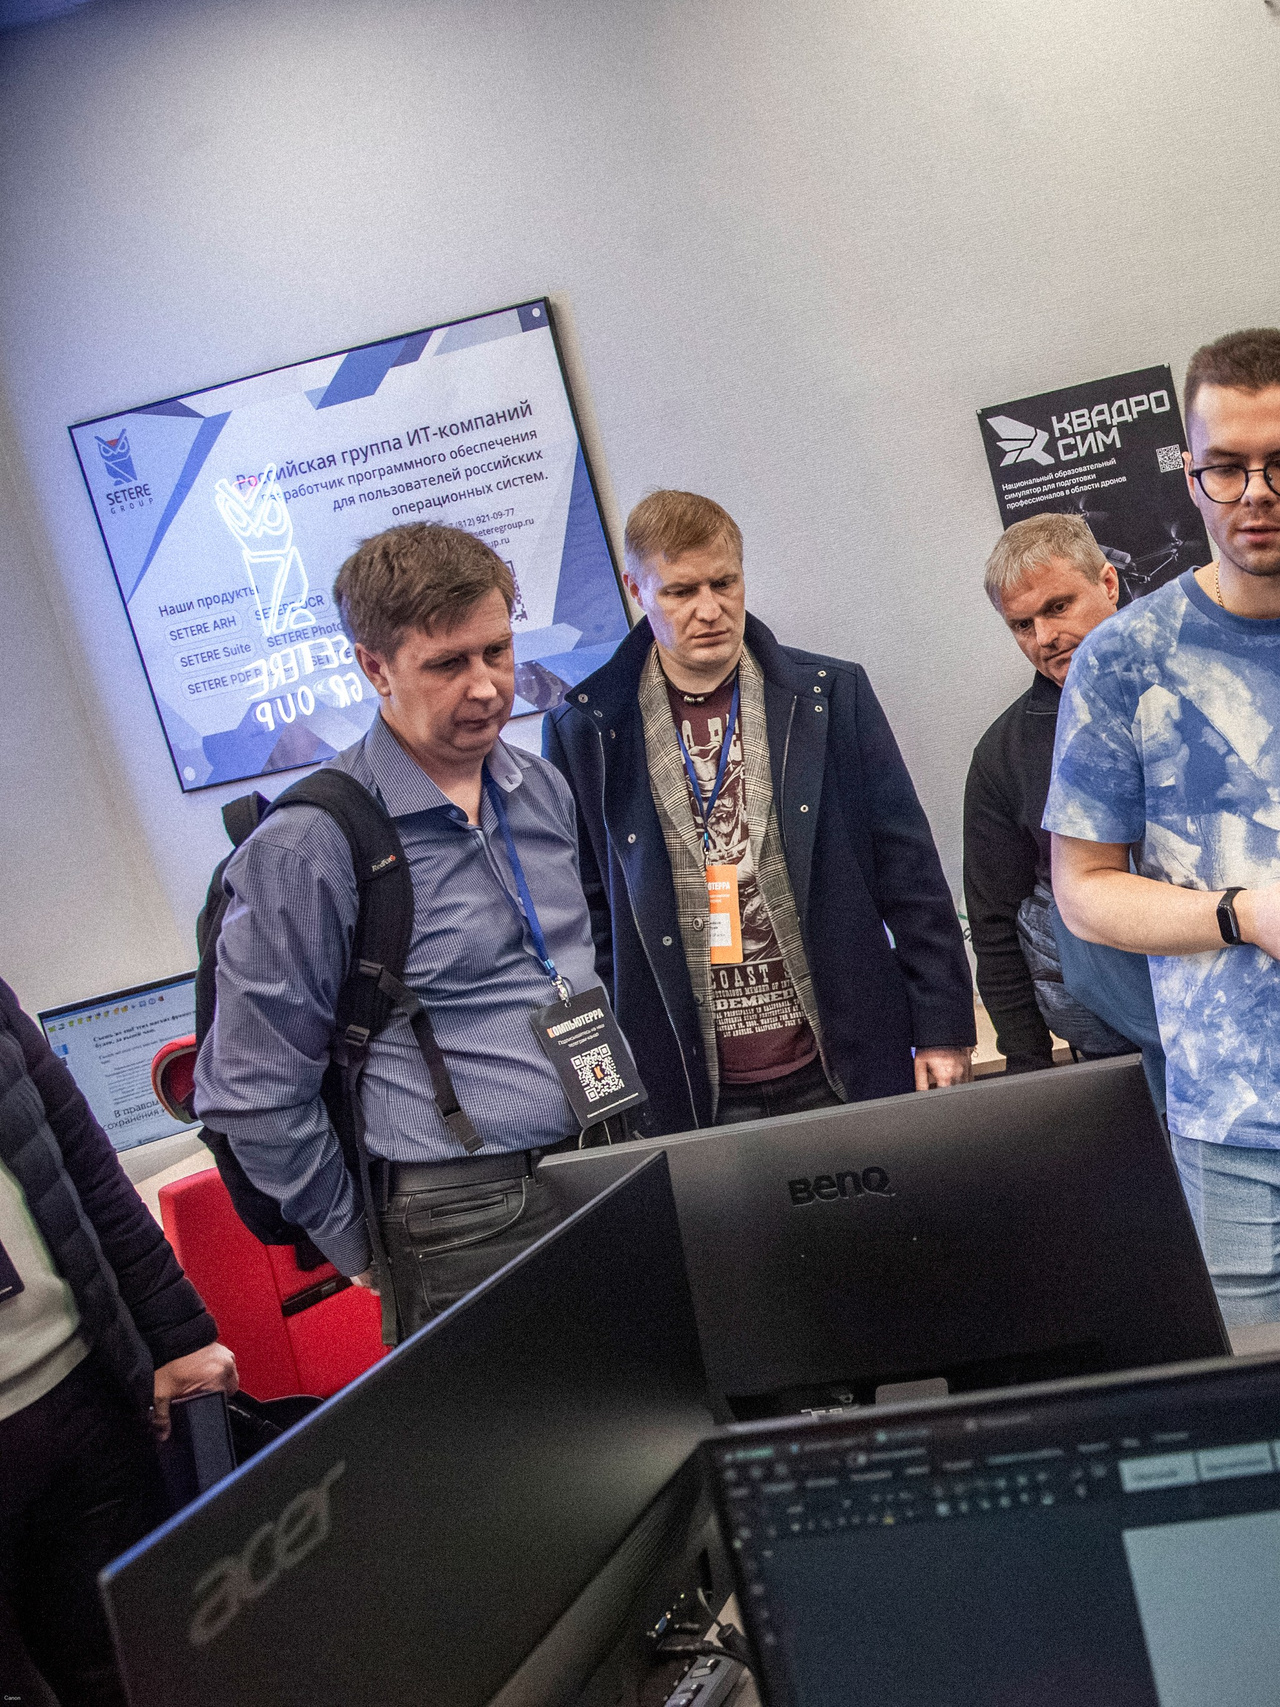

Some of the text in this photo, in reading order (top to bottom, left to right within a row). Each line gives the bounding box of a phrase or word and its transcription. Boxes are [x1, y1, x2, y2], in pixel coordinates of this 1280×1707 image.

[1051, 389, 1171, 438] КВАДРО
[236, 399, 533, 490] Российская группа ИТ-компаний
[1057, 426, 1122, 461] СИМ
[347, 452, 447, 486] программного
[449, 429, 538, 460] обеспечения
[333, 449, 544, 512] для пользователей российских
[1001, 457, 1117, 491] Национальный образовательный
[1004, 473, 1097, 500] симулятор для подготовки
[106, 484, 152, 506] SETERE
[110, 497, 154, 515] GROUP
[391, 471, 549, 516] операционных систем.
[1006, 490, 1065, 510] профессионалов
[1070, 482, 1100, 494] области
[1100, 476, 1127, 488] дронов
[474, 517, 534, 538] seteregroup.ru
[476, 507, 515, 524] 921-09-77
[158, 585, 260, 618] Наши продукты
[254, 600, 297, 620] SEERE
[169, 615, 237, 641] SETERE ARH
[266, 628, 310, 648] SETERE
[179, 643, 252, 668] SETERE Suite
[187, 674, 229, 695] SETERE
[230, 670, 252, 687] PDF
[707, 881, 731, 890] ТЕРРА
[709, 963, 769, 989] COAST
[714, 988, 795, 1011] DEMNED
[546, 1008, 604, 1038] КОМПЬЮТЕРРА
[716, 1016, 743, 1025] ALIFORNIA
[788, 1166, 894, 1207] BenQ
[188, 1460, 346, 1646] acer
